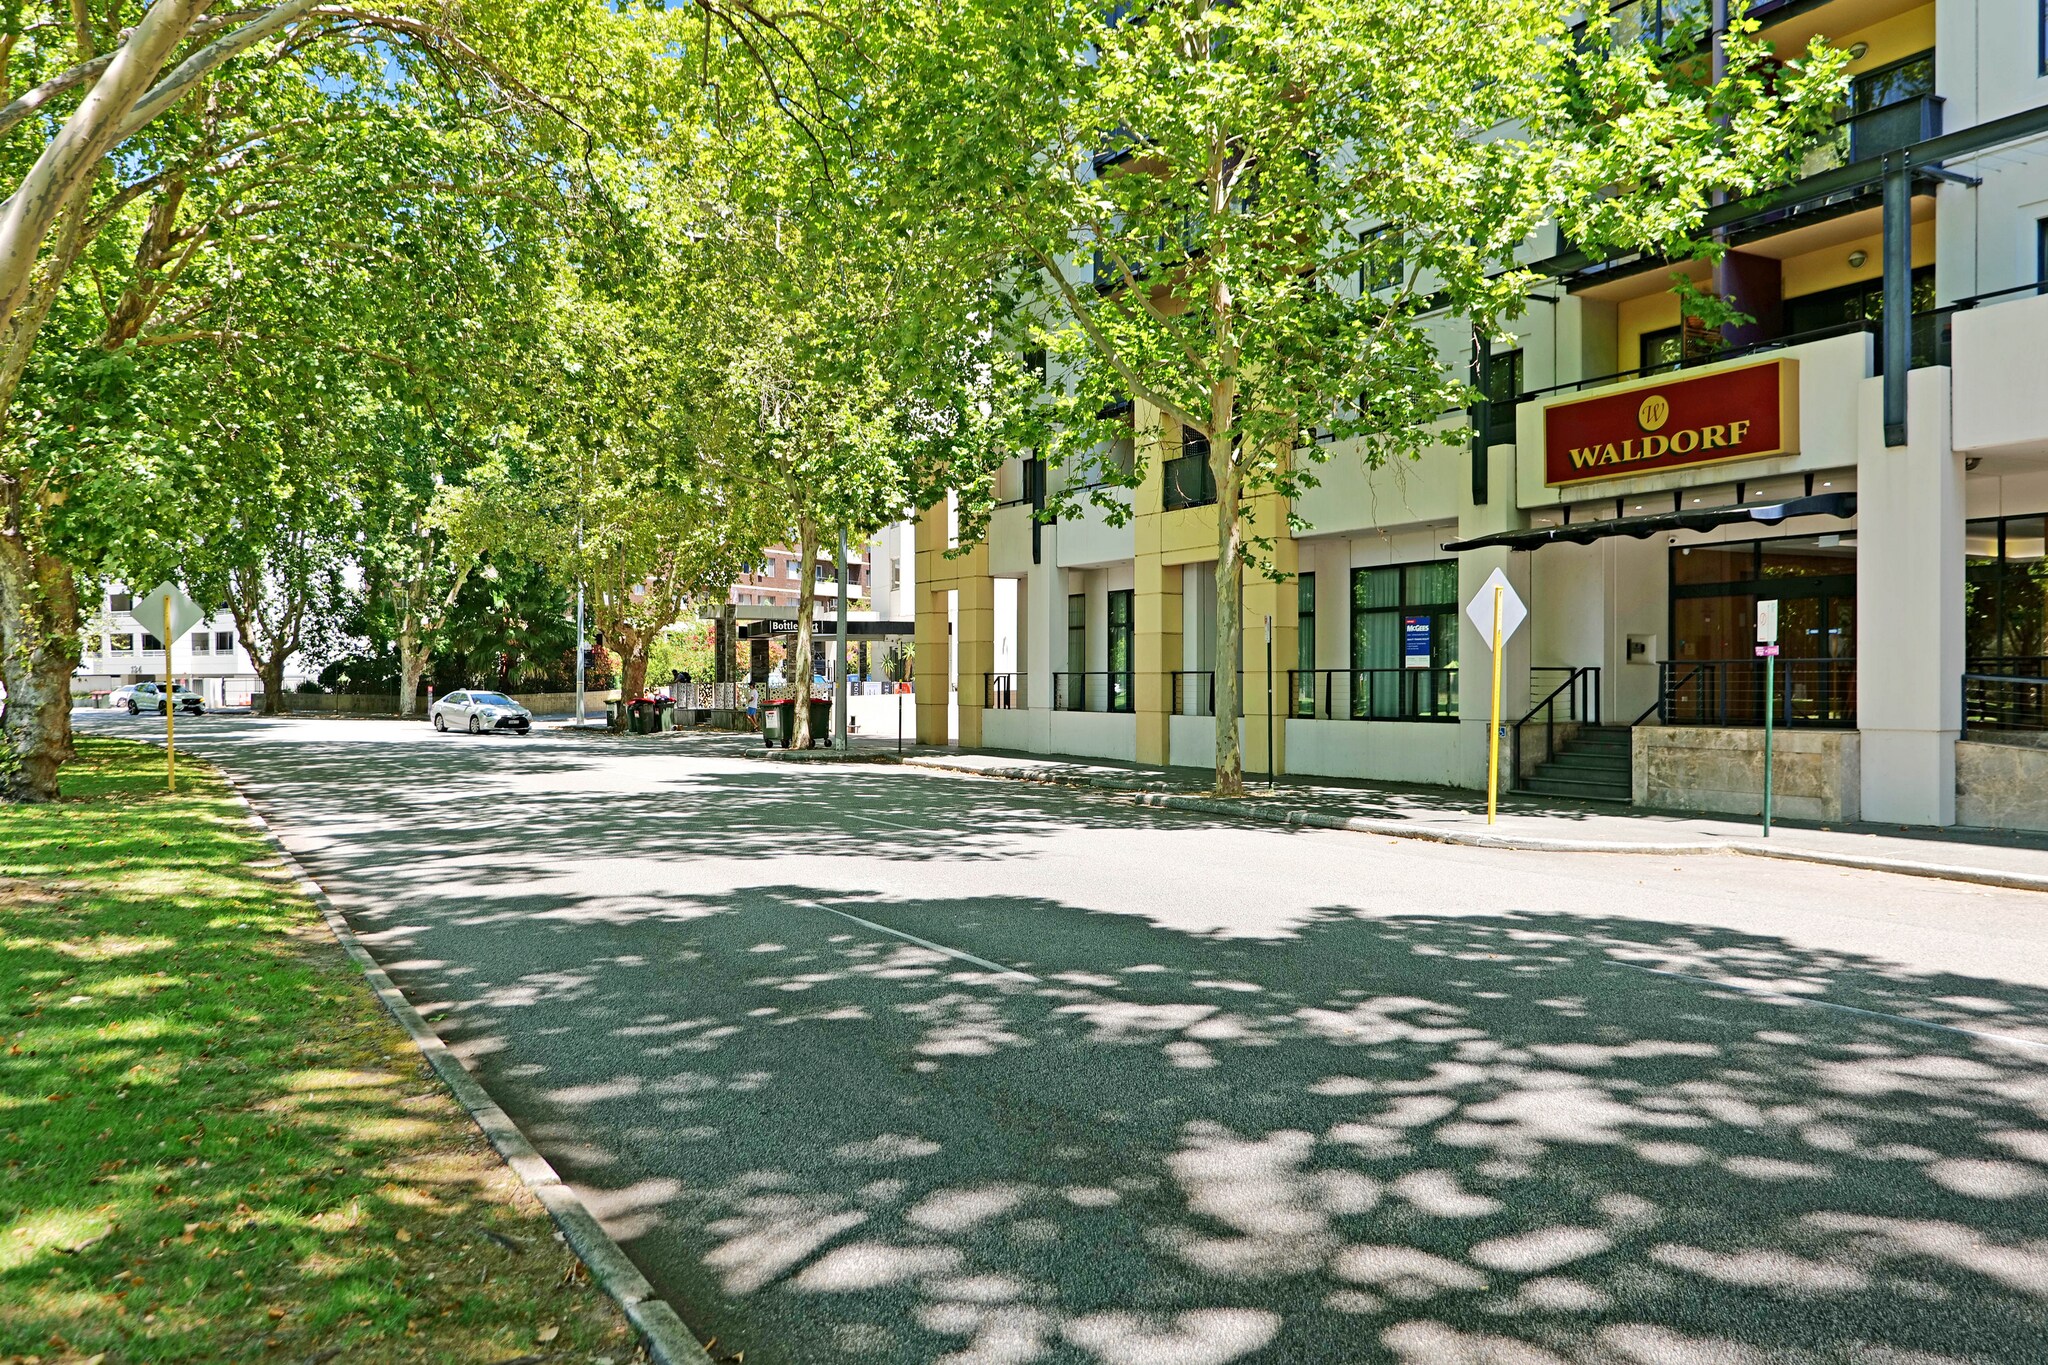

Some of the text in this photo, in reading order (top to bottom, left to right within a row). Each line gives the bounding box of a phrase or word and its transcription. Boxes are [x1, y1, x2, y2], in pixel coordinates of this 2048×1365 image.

[1642, 403, 1665, 424] W
[1569, 420, 1750, 469] WALDORF
[773, 622, 818, 630] Bottlert
